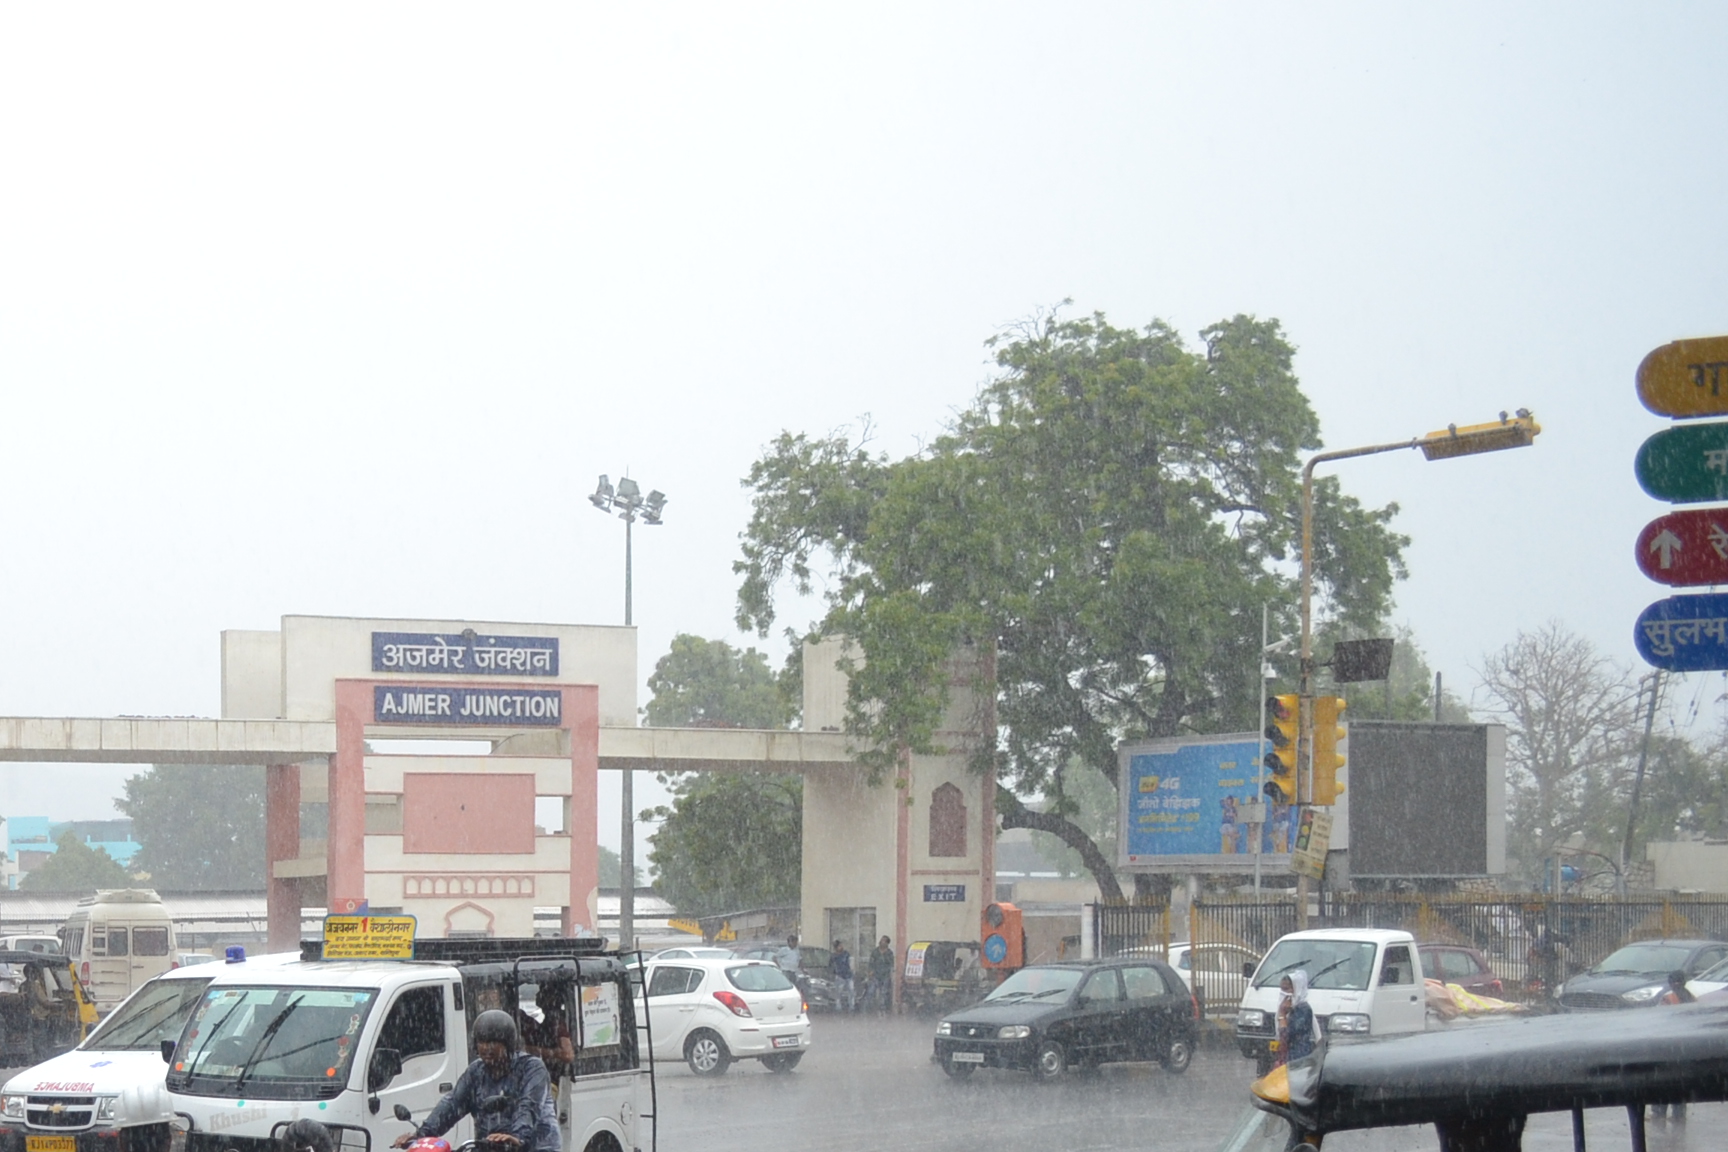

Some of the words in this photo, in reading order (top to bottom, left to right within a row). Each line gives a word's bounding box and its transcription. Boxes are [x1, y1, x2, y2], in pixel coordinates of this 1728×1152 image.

[382, 637, 466, 669] अजमेर
[474, 638, 553, 671] जंक्शन
[382, 693, 451, 715] AJMER
[460, 695, 559, 717] JUNCTION
[1160, 778, 1180, 789] 4G
